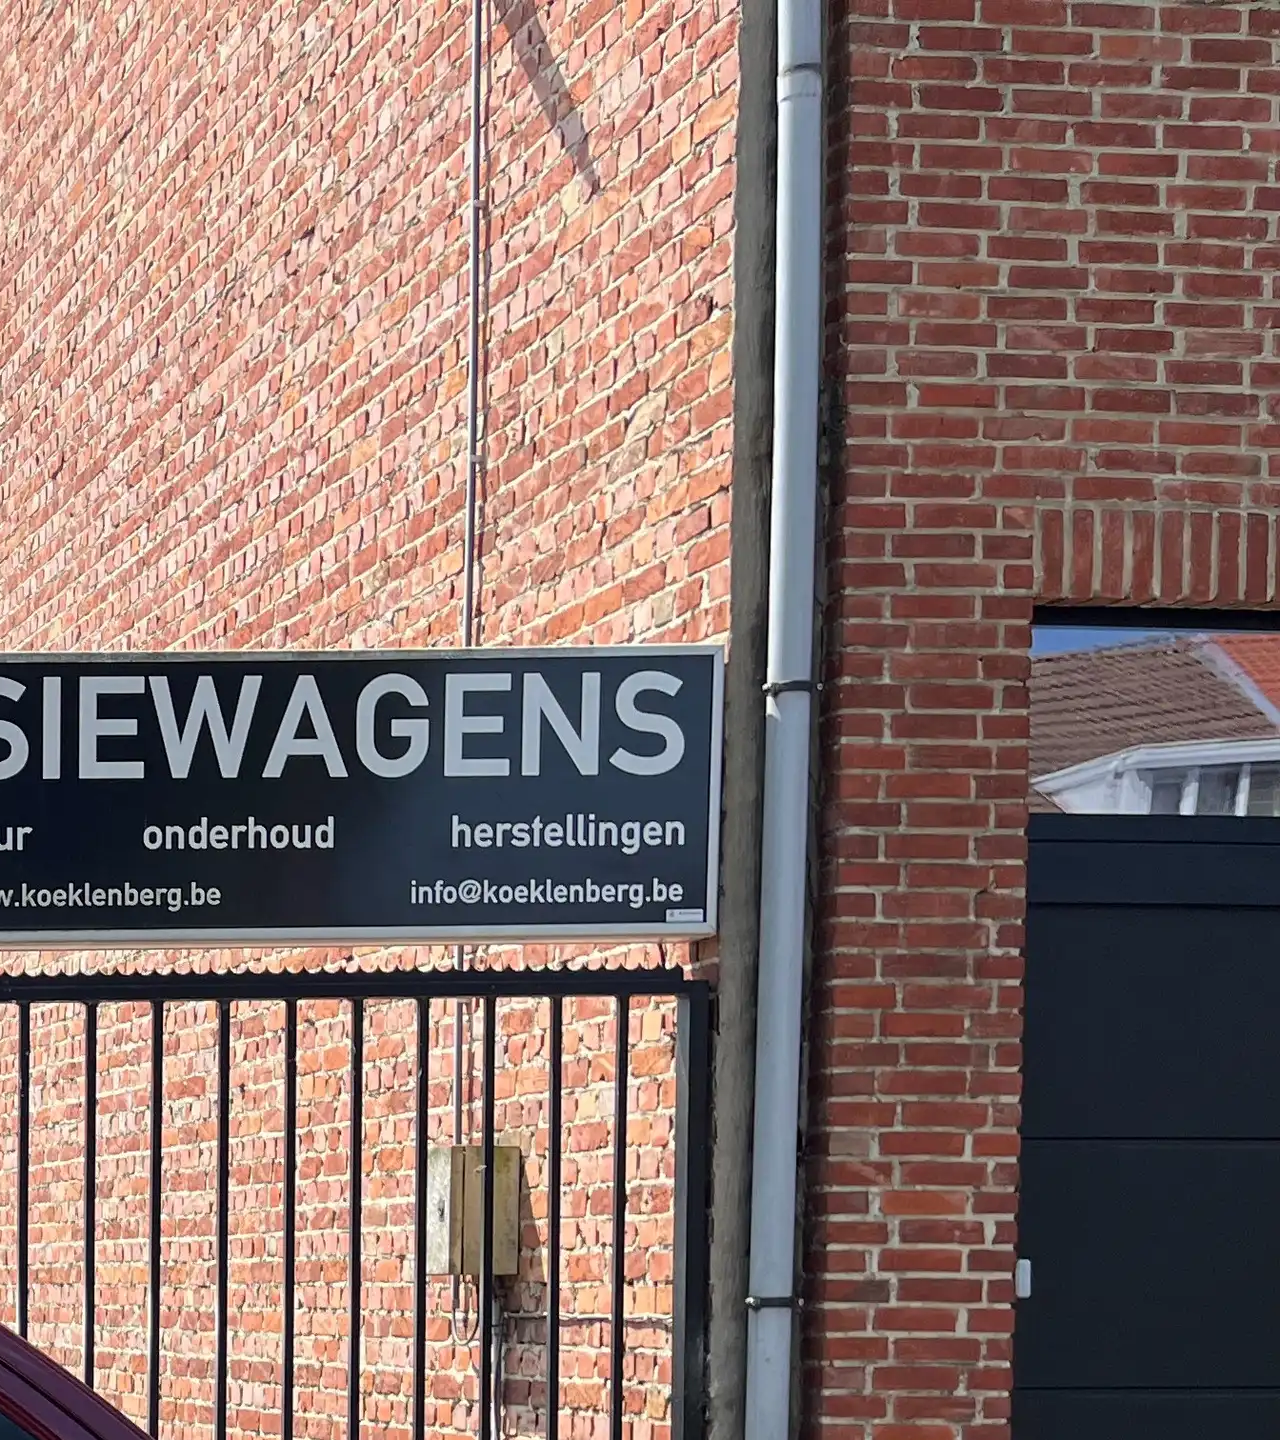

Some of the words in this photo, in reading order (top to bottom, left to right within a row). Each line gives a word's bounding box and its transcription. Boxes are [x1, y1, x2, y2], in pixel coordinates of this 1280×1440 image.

[143, 815, 335, 850] onderhoud
[451, 813, 686, 855] herstellingen
[410, 878, 684, 909] info@koeklenberg.be
